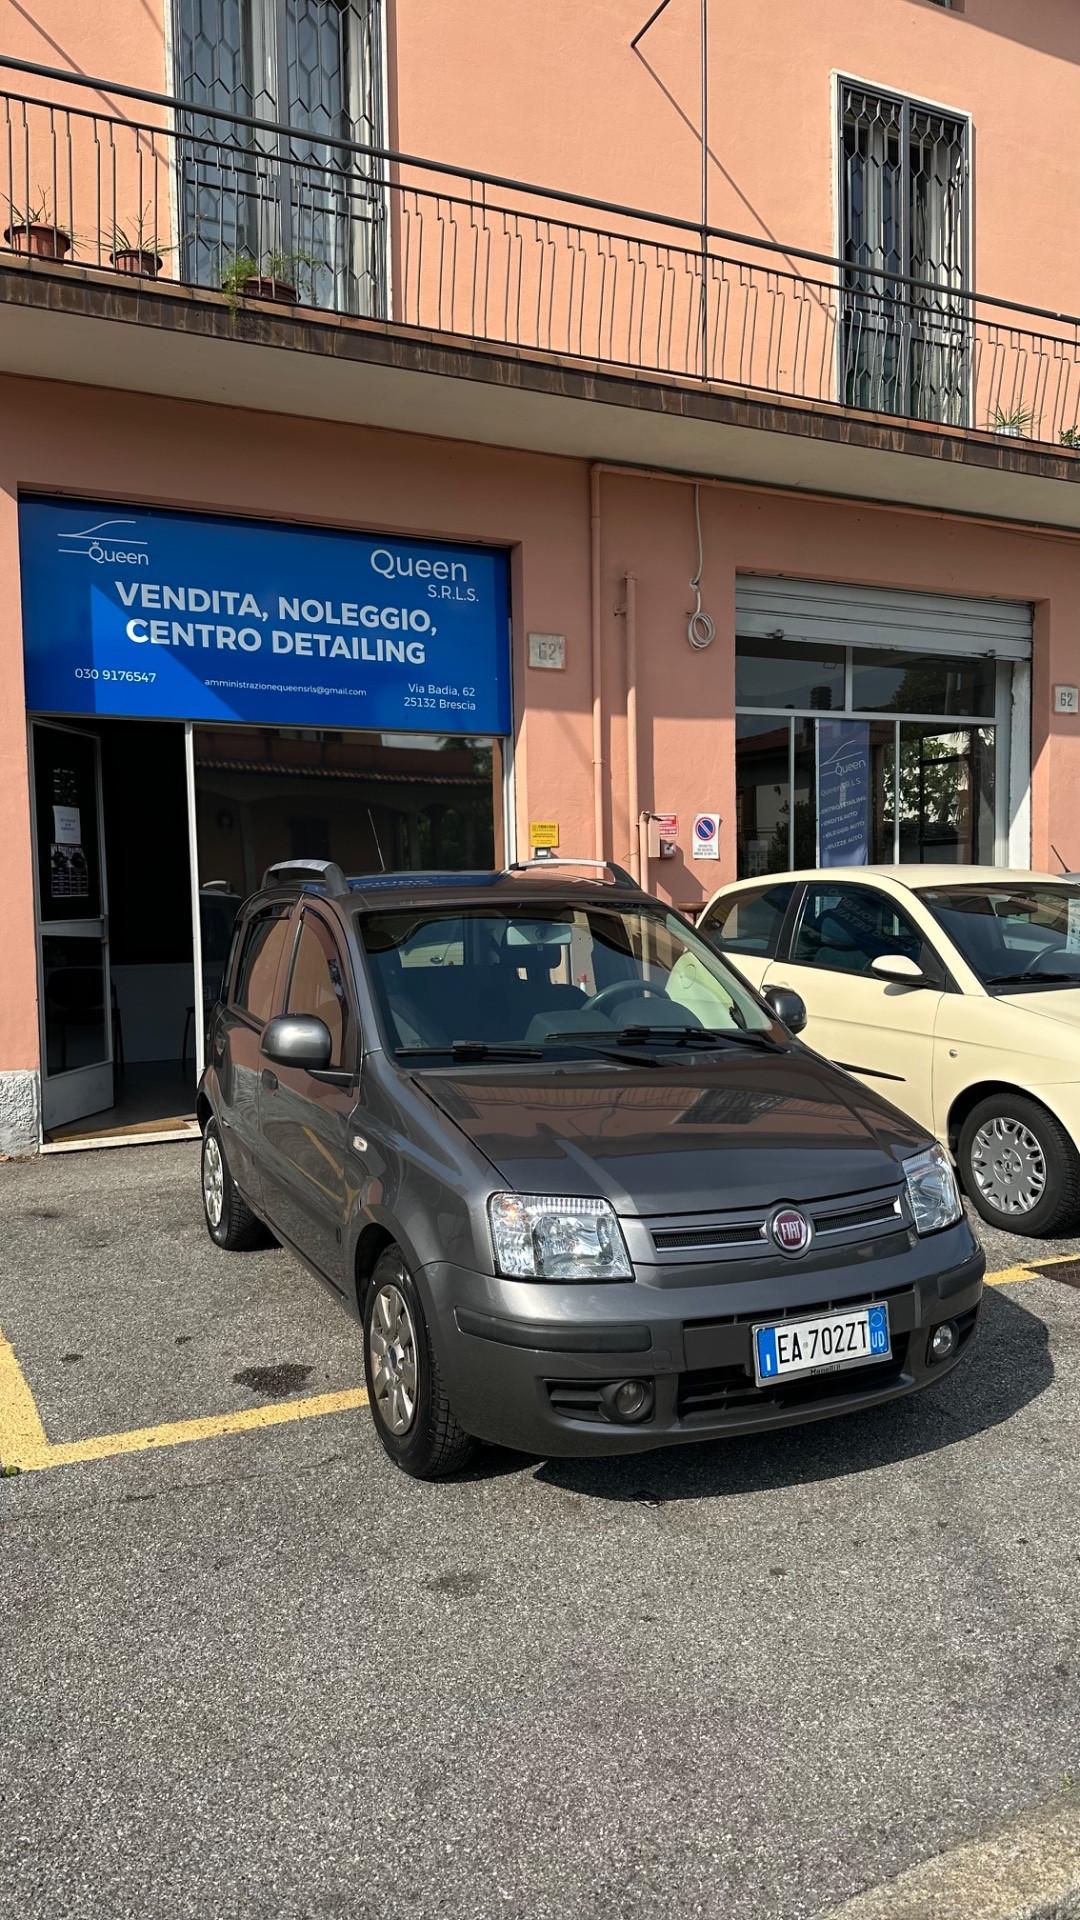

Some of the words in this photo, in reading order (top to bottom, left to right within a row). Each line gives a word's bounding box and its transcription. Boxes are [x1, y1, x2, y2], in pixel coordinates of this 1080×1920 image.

[88, 546, 149, 565] Queen
[370, 549, 468, 582] Queen
[427, 584, 480, 602] S.R.L.S.
[114, 581, 269, 622] VENDITA,
[278, 596, 437, 637] NOLEGGIO,
[126, 618, 262, 652] CENTRO
[271, 630, 426, 665] DETAILING
[75, 668, 99, 680] 030
[102, 670, 157, 683] 9176547
[204, 678, 367, 696] amministrazionequeensrls@gmail.com
[408, 683, 425, 695] Via
[428, 685, 460, 697] Badia,
[462, 687, 475, 697] 62
[404, 697, 436, 709] 25132
[439, 699, 476, 711] Brescia
[1060, 692, 1073, 707] 62
[835, 759, 866, 776] Queen
[781, 1221, 801, 1241] FIAT
[766, 1354, 771, 1371] I
[778, 1332, 802, 1364] EA
[808, 1320, 868, 1359] 702ZT
[871, 1331, 885, 1349] UD
